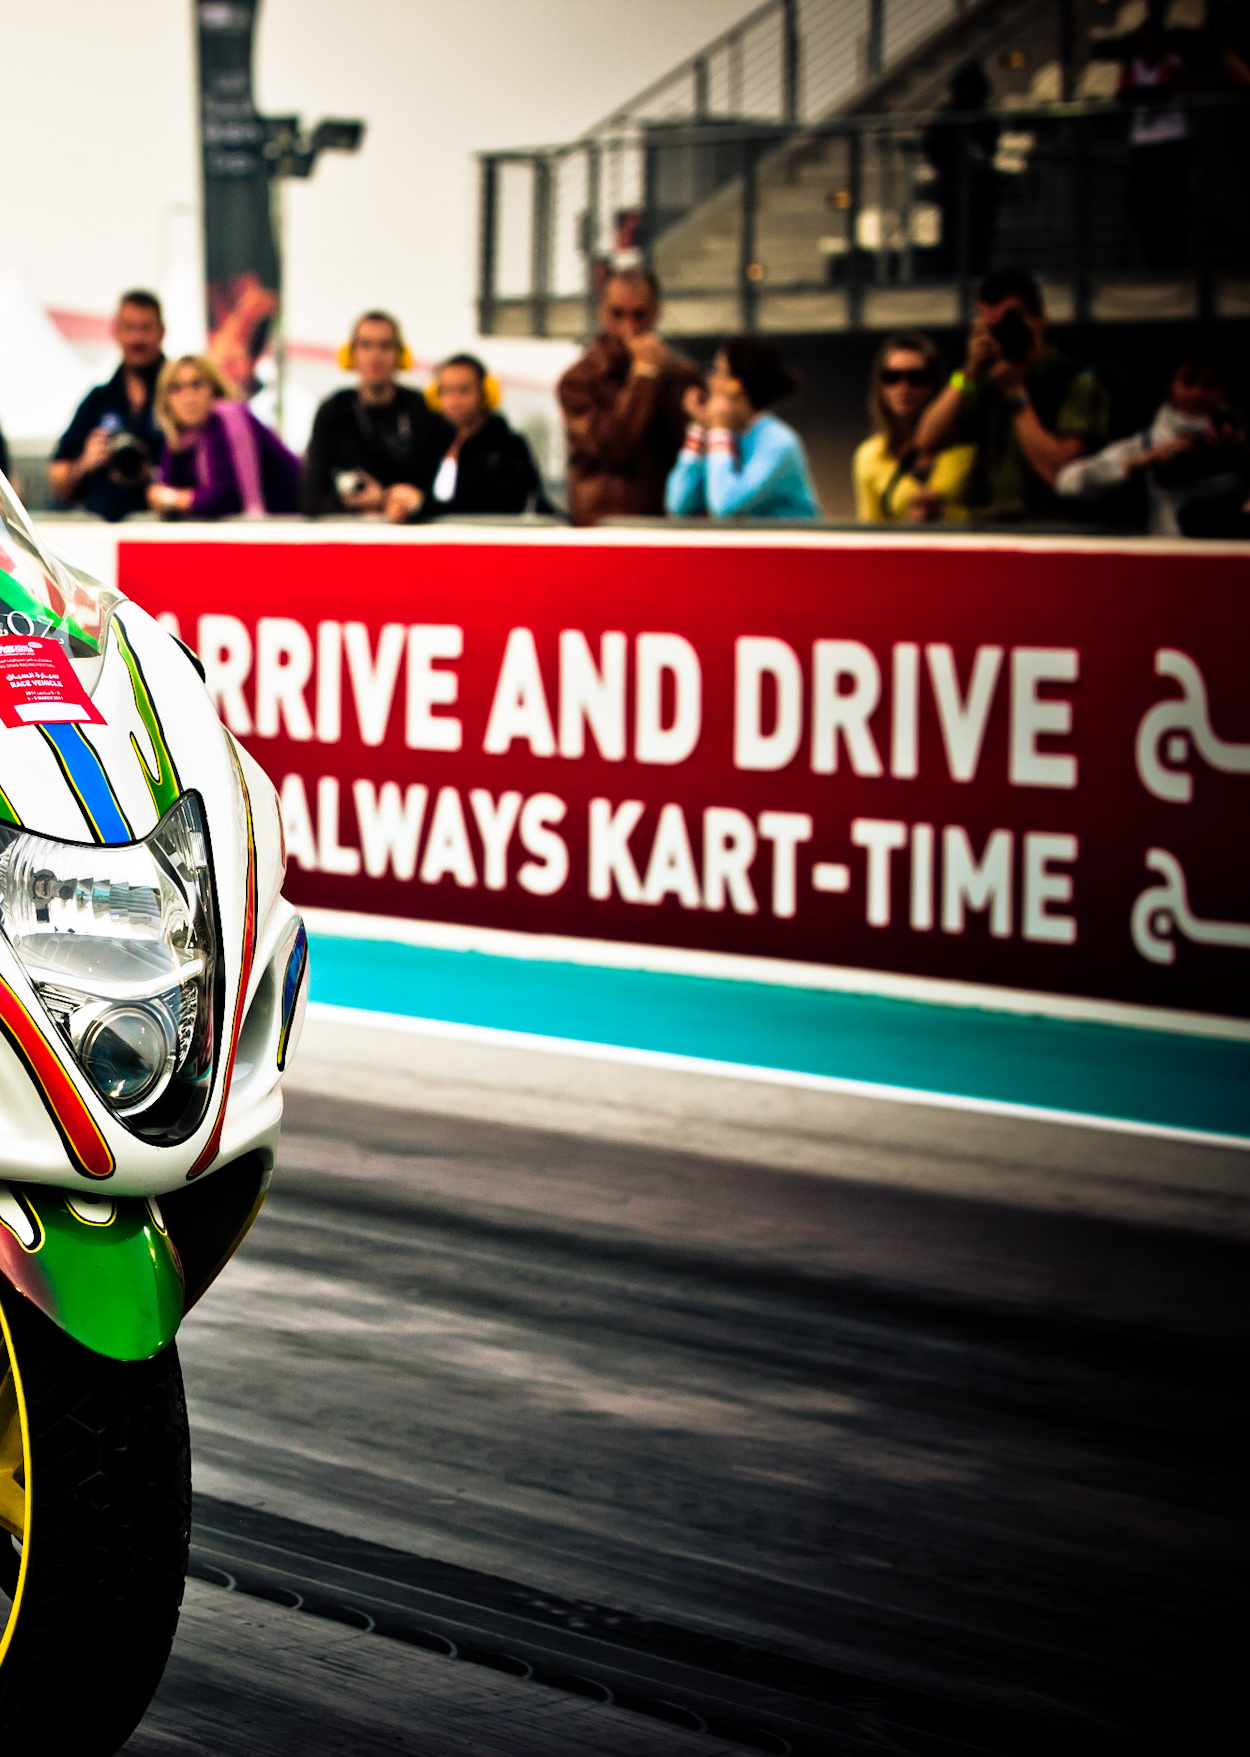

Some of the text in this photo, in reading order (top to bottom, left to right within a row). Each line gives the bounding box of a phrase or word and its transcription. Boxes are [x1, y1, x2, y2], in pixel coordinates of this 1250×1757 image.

[9, 680, 32, 688] RACE
[156, 611, 464, 752] RRIVE
[483, 627, 702, 765] AND
[733, 636, 1078, 788] DRIVE
[279, 773, 569, 896] ALWAYS
[588, 797, 1077, 943] KART-TIME
